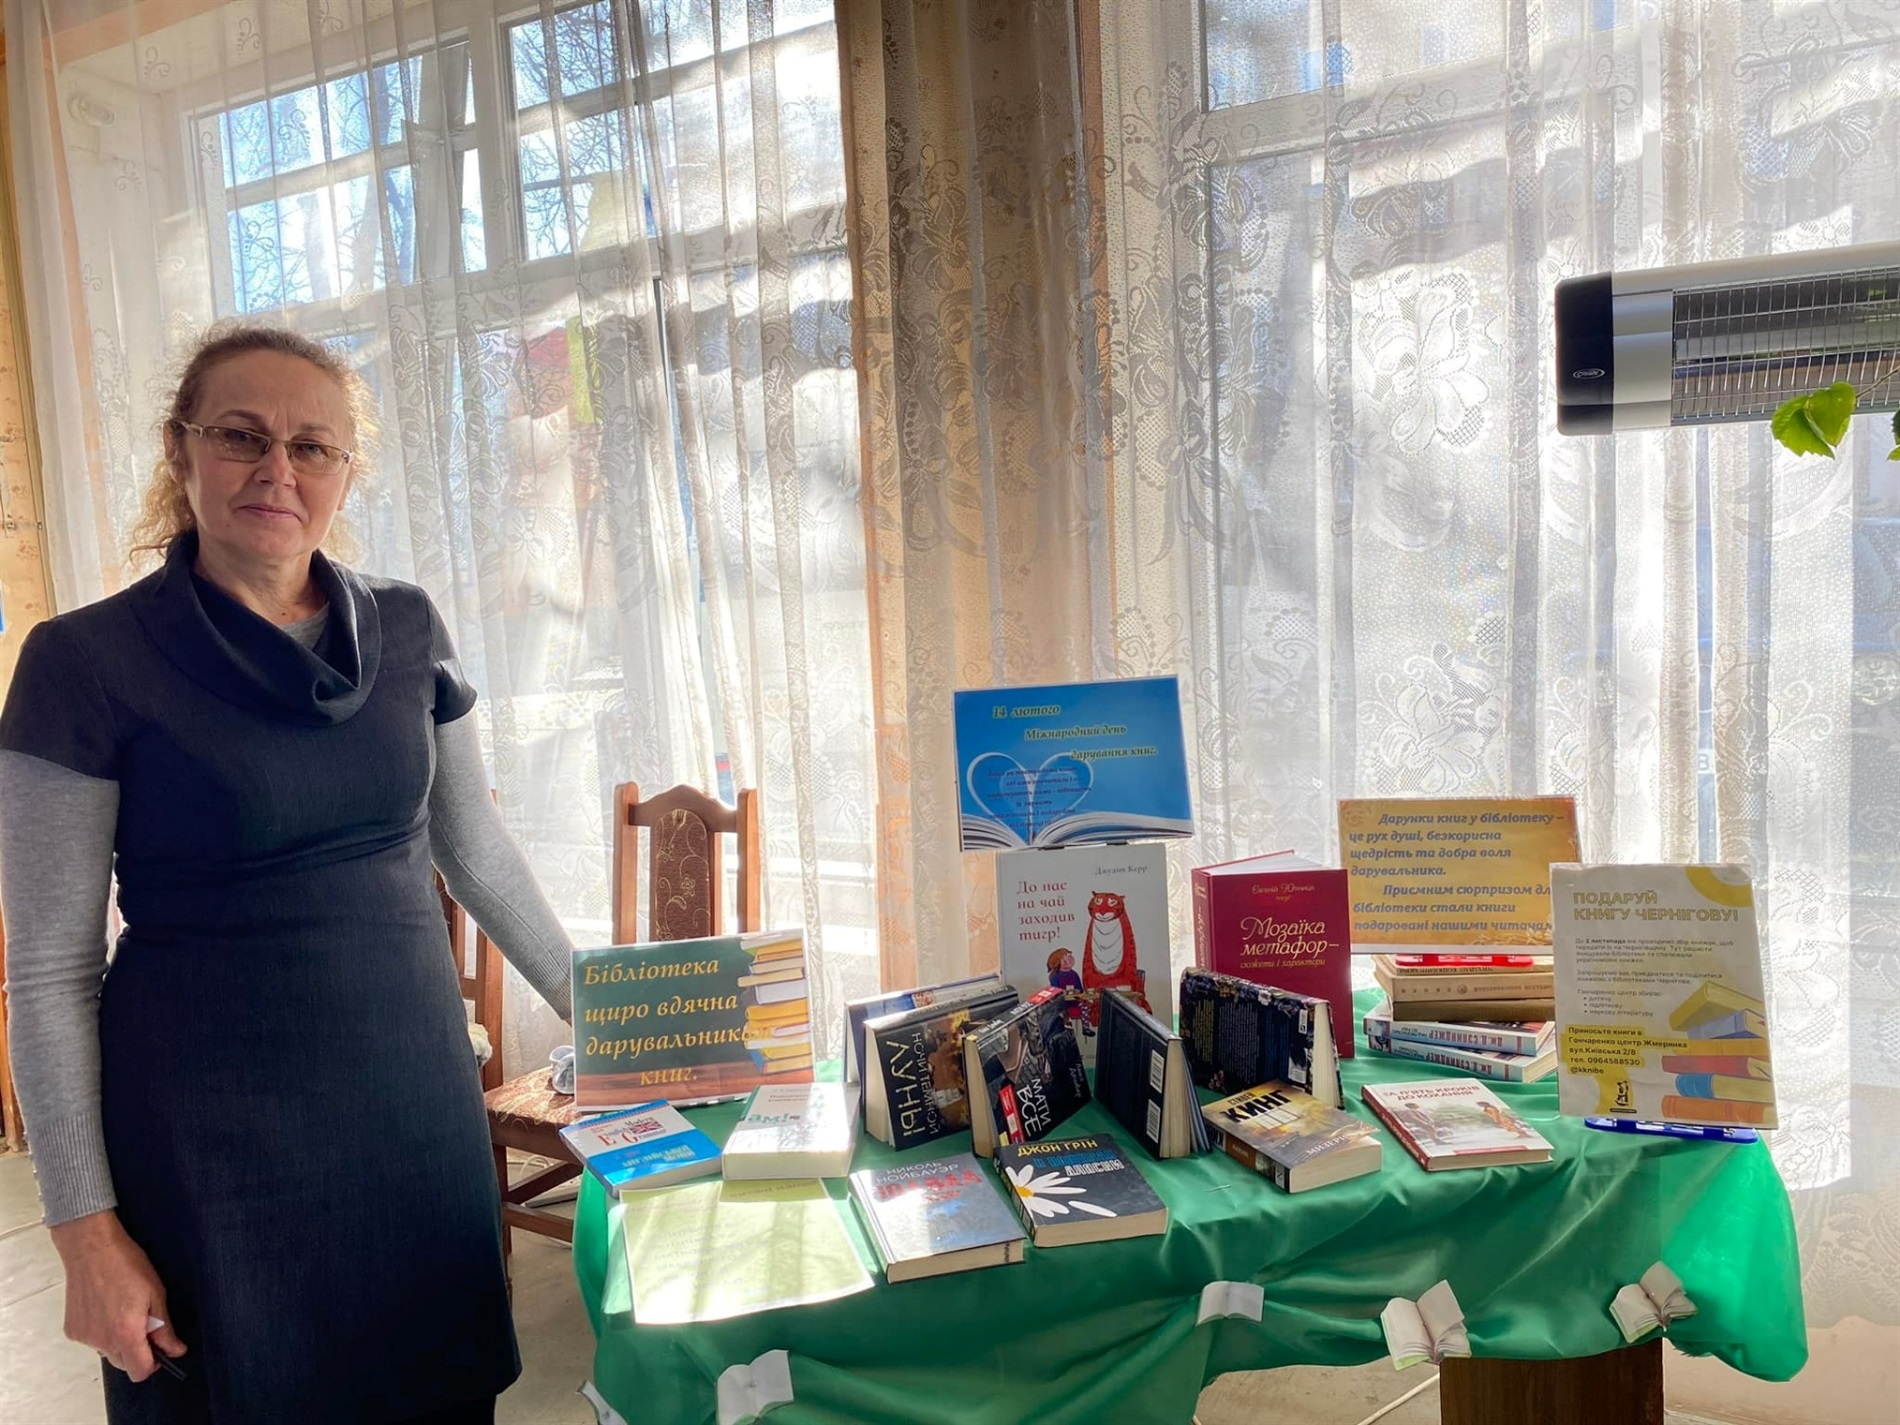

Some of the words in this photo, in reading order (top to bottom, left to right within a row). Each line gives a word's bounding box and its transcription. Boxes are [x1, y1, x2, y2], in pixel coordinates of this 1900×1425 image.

[993, 707, 1006, 718] 14
[1012, 705, 1060, 718] лютого
[1025, 727, 1101, 741] Міжнародний
[1103, 725, 1126, 736] день
[1071, 749, 1129, 761] дарування
[1379, 813, 1434, 825] Дарунки
[1437, 814, 1467, 824] книг
[1470, 816, 1477, 825] у
[1480, 812, 1553, 824] бібліотеку
[1349, 832, 1364, 842] це
[1366, 832, 1388, 843] рух
[1390, 830, 1424, 842] душі,
[1427, 831, 1501, 841] безкорисна
[1350, 848, 1412, 860] щедрість
[1415, 849, 1435, 858] та
[1439, 847, 1477, 859] добра
[1480, 849, 1511, 858] воля
[1351, 866, 1447, 877] дарувальника.
[1017, 881, 1038, 894] До
[1043, 881, 1068, 892] нас
[1383, 885, 1453, 897] Приємним
[1456, 885, 1532, 896] сюрпризом
[1535, 884, 1551, 895] дл
[1018, 899, 1035, 909] на
[1040, 896, 1066, 907] чай
[1574, 890, 1658, 906] ПОДАРУЙ
[1353, 903, 1427, 914] бібліотеки
[1430, 904, 1474, 913] стали
[1476, 903, 1516, 913] книги
[1574, 908, 1630, 921] КНИГУ
[1635, 909, 1739, 922] ЧЕРНІГОВУ!
[1018, 913, 1075, 926] заходив
[1354, 920, 1429, 932] подаровані
[1432, 921, 1488, 931] нашими
[1019, 926, 1061, 943] тигр!
[1240, 916, 1325, 943] Мозаїка
[584, 959, 719, 986] Бібліотека
[585, 1003, 649, 1026] щиро
[657, 994, 739, 1017] вдячна
[1569, 1027, 1611, 1036] Приносьте
[1569, 1037, 1615, 1045] Гончаренко
[1644, 1040, 1687, 1048] Жмеринка
[641, 1067, 698, 1086] книг.
[886, 1041, 925, 1136] ЛУНЫ
[912, 1033, 928, 1072] НОЧИ
[920, 1074, 940, 1134] ТЕМНОЙ
[1031, 1079, 1051, 1126] МАТИ
[1217, 1090, 1292, 1123] КИНГ
[1017, 1084, 1042, 1136] ВСЕ
[1017, 1144, 1061, 1157] ДЖОН
[876, 1164, 958, 1183] НОЙБАУЭР
[887, 1162, 942, 1174] НИКОЛЬ
